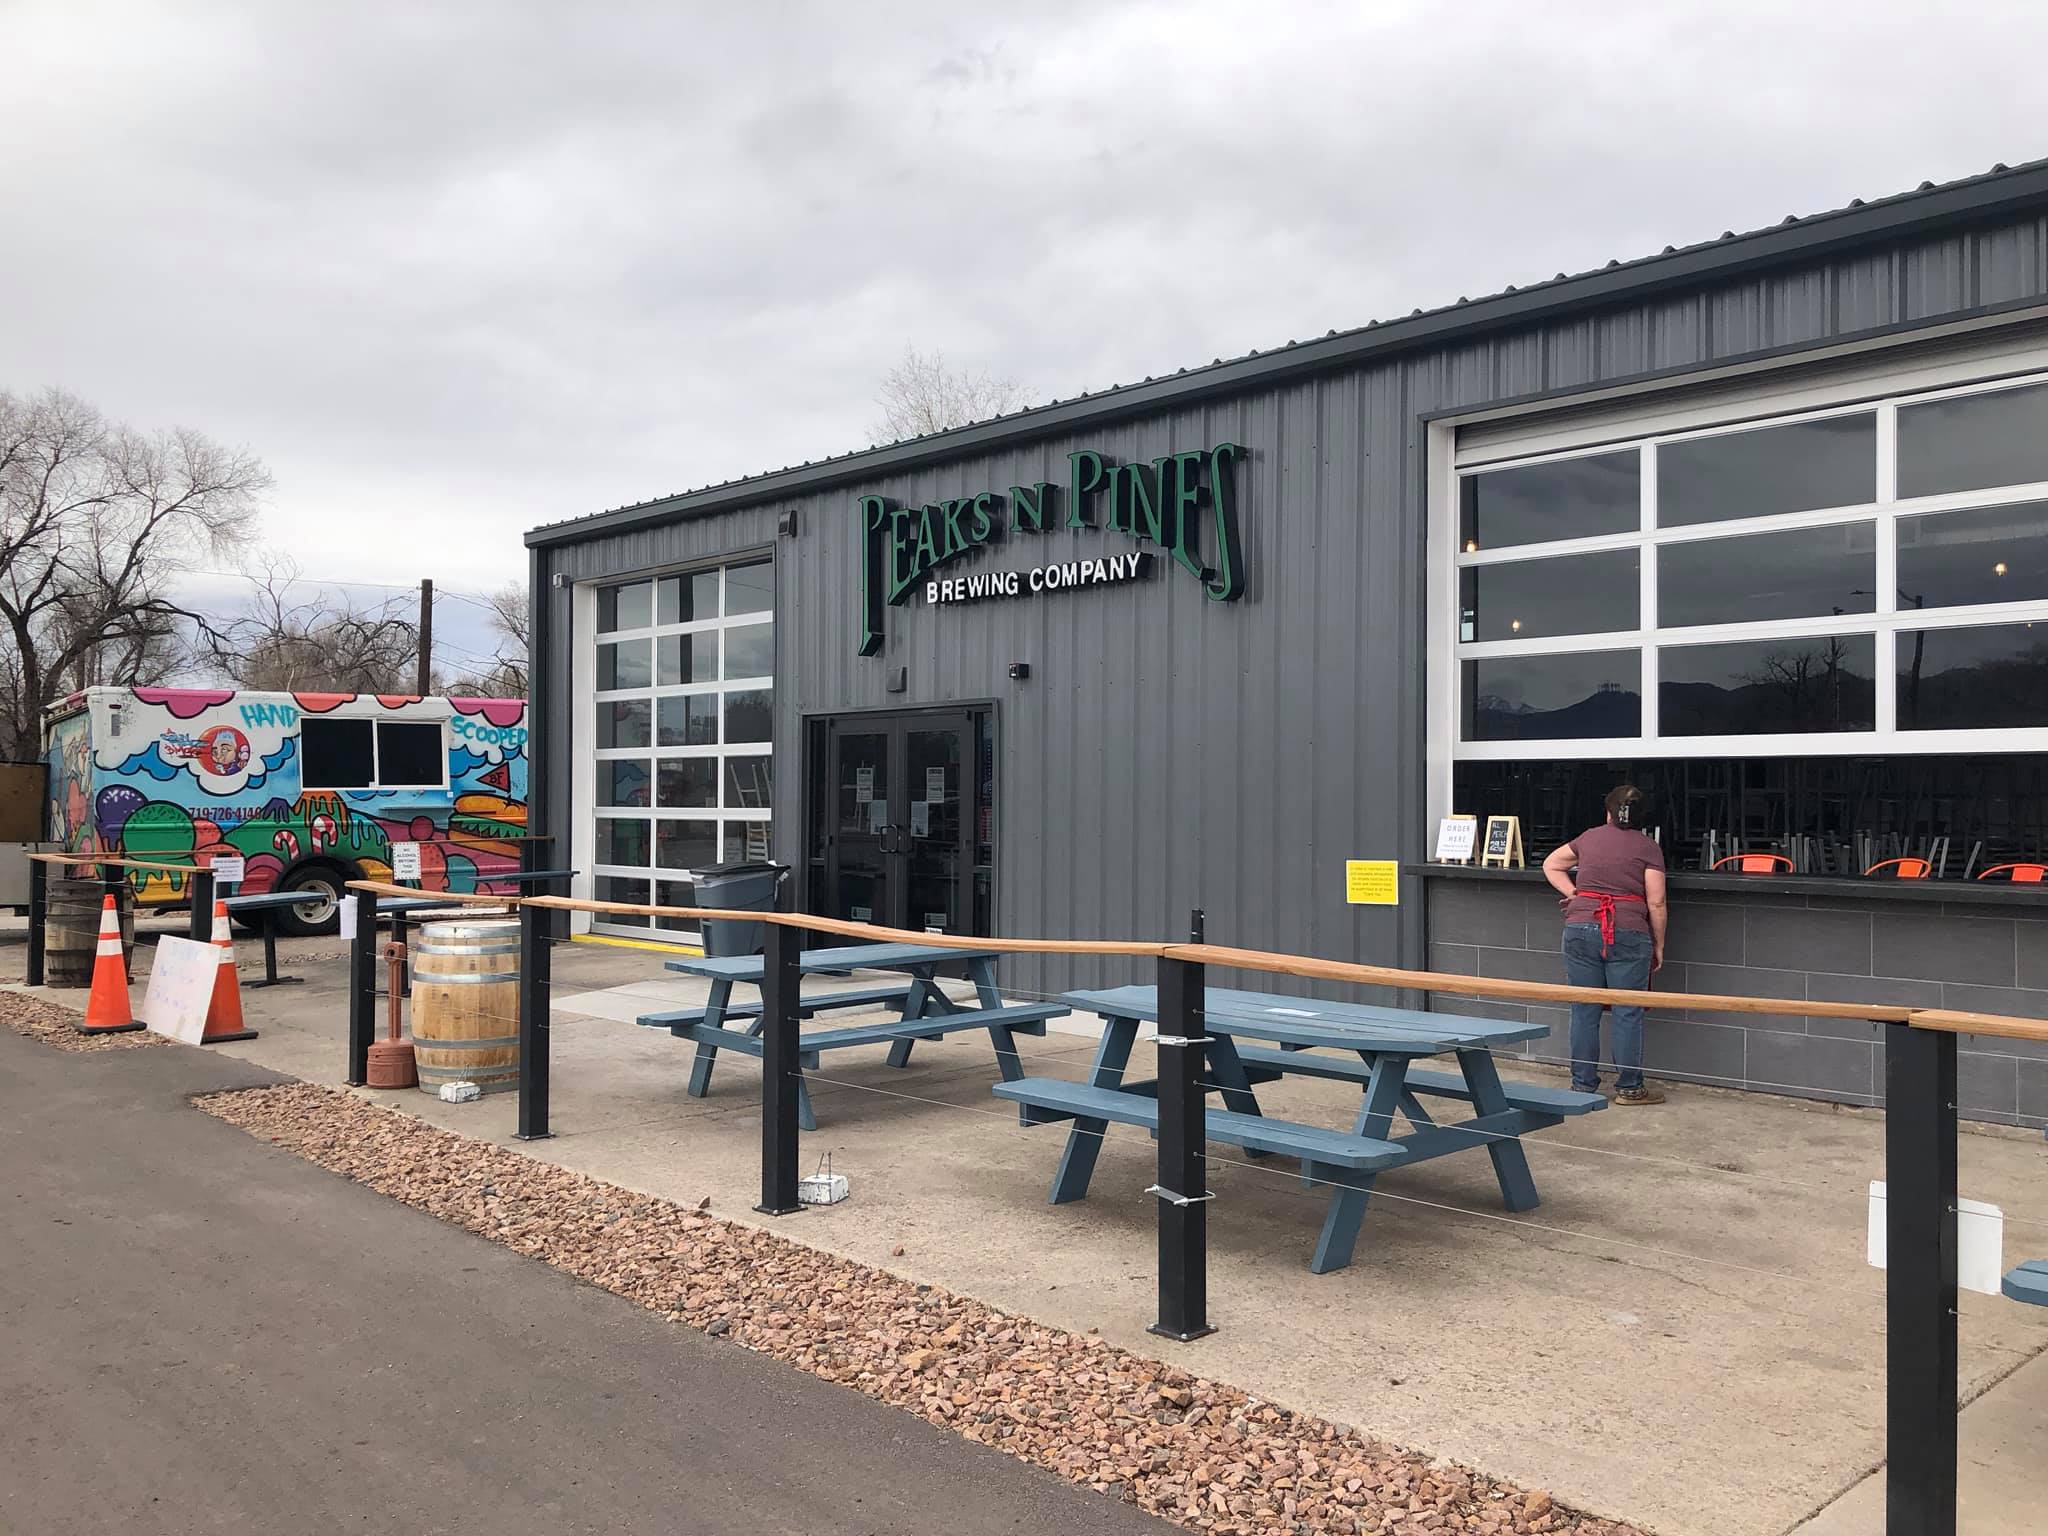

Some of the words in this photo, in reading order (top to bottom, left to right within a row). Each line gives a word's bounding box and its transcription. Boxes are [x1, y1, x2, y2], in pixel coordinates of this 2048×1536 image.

[858, 493, 1000, 656] PEAKS
[1009, 483, 1056, 532] N
[1066, 443, 1241, 600] PINES
[926, 571, 1019, 604] BREWING
[1029, 551, 1142, 592] COMPANY
[240, 703, 298, 729] HAND
[451, 715, 528, 745] SCOOPED
[1446, 825, 1470, 833] ORDER
